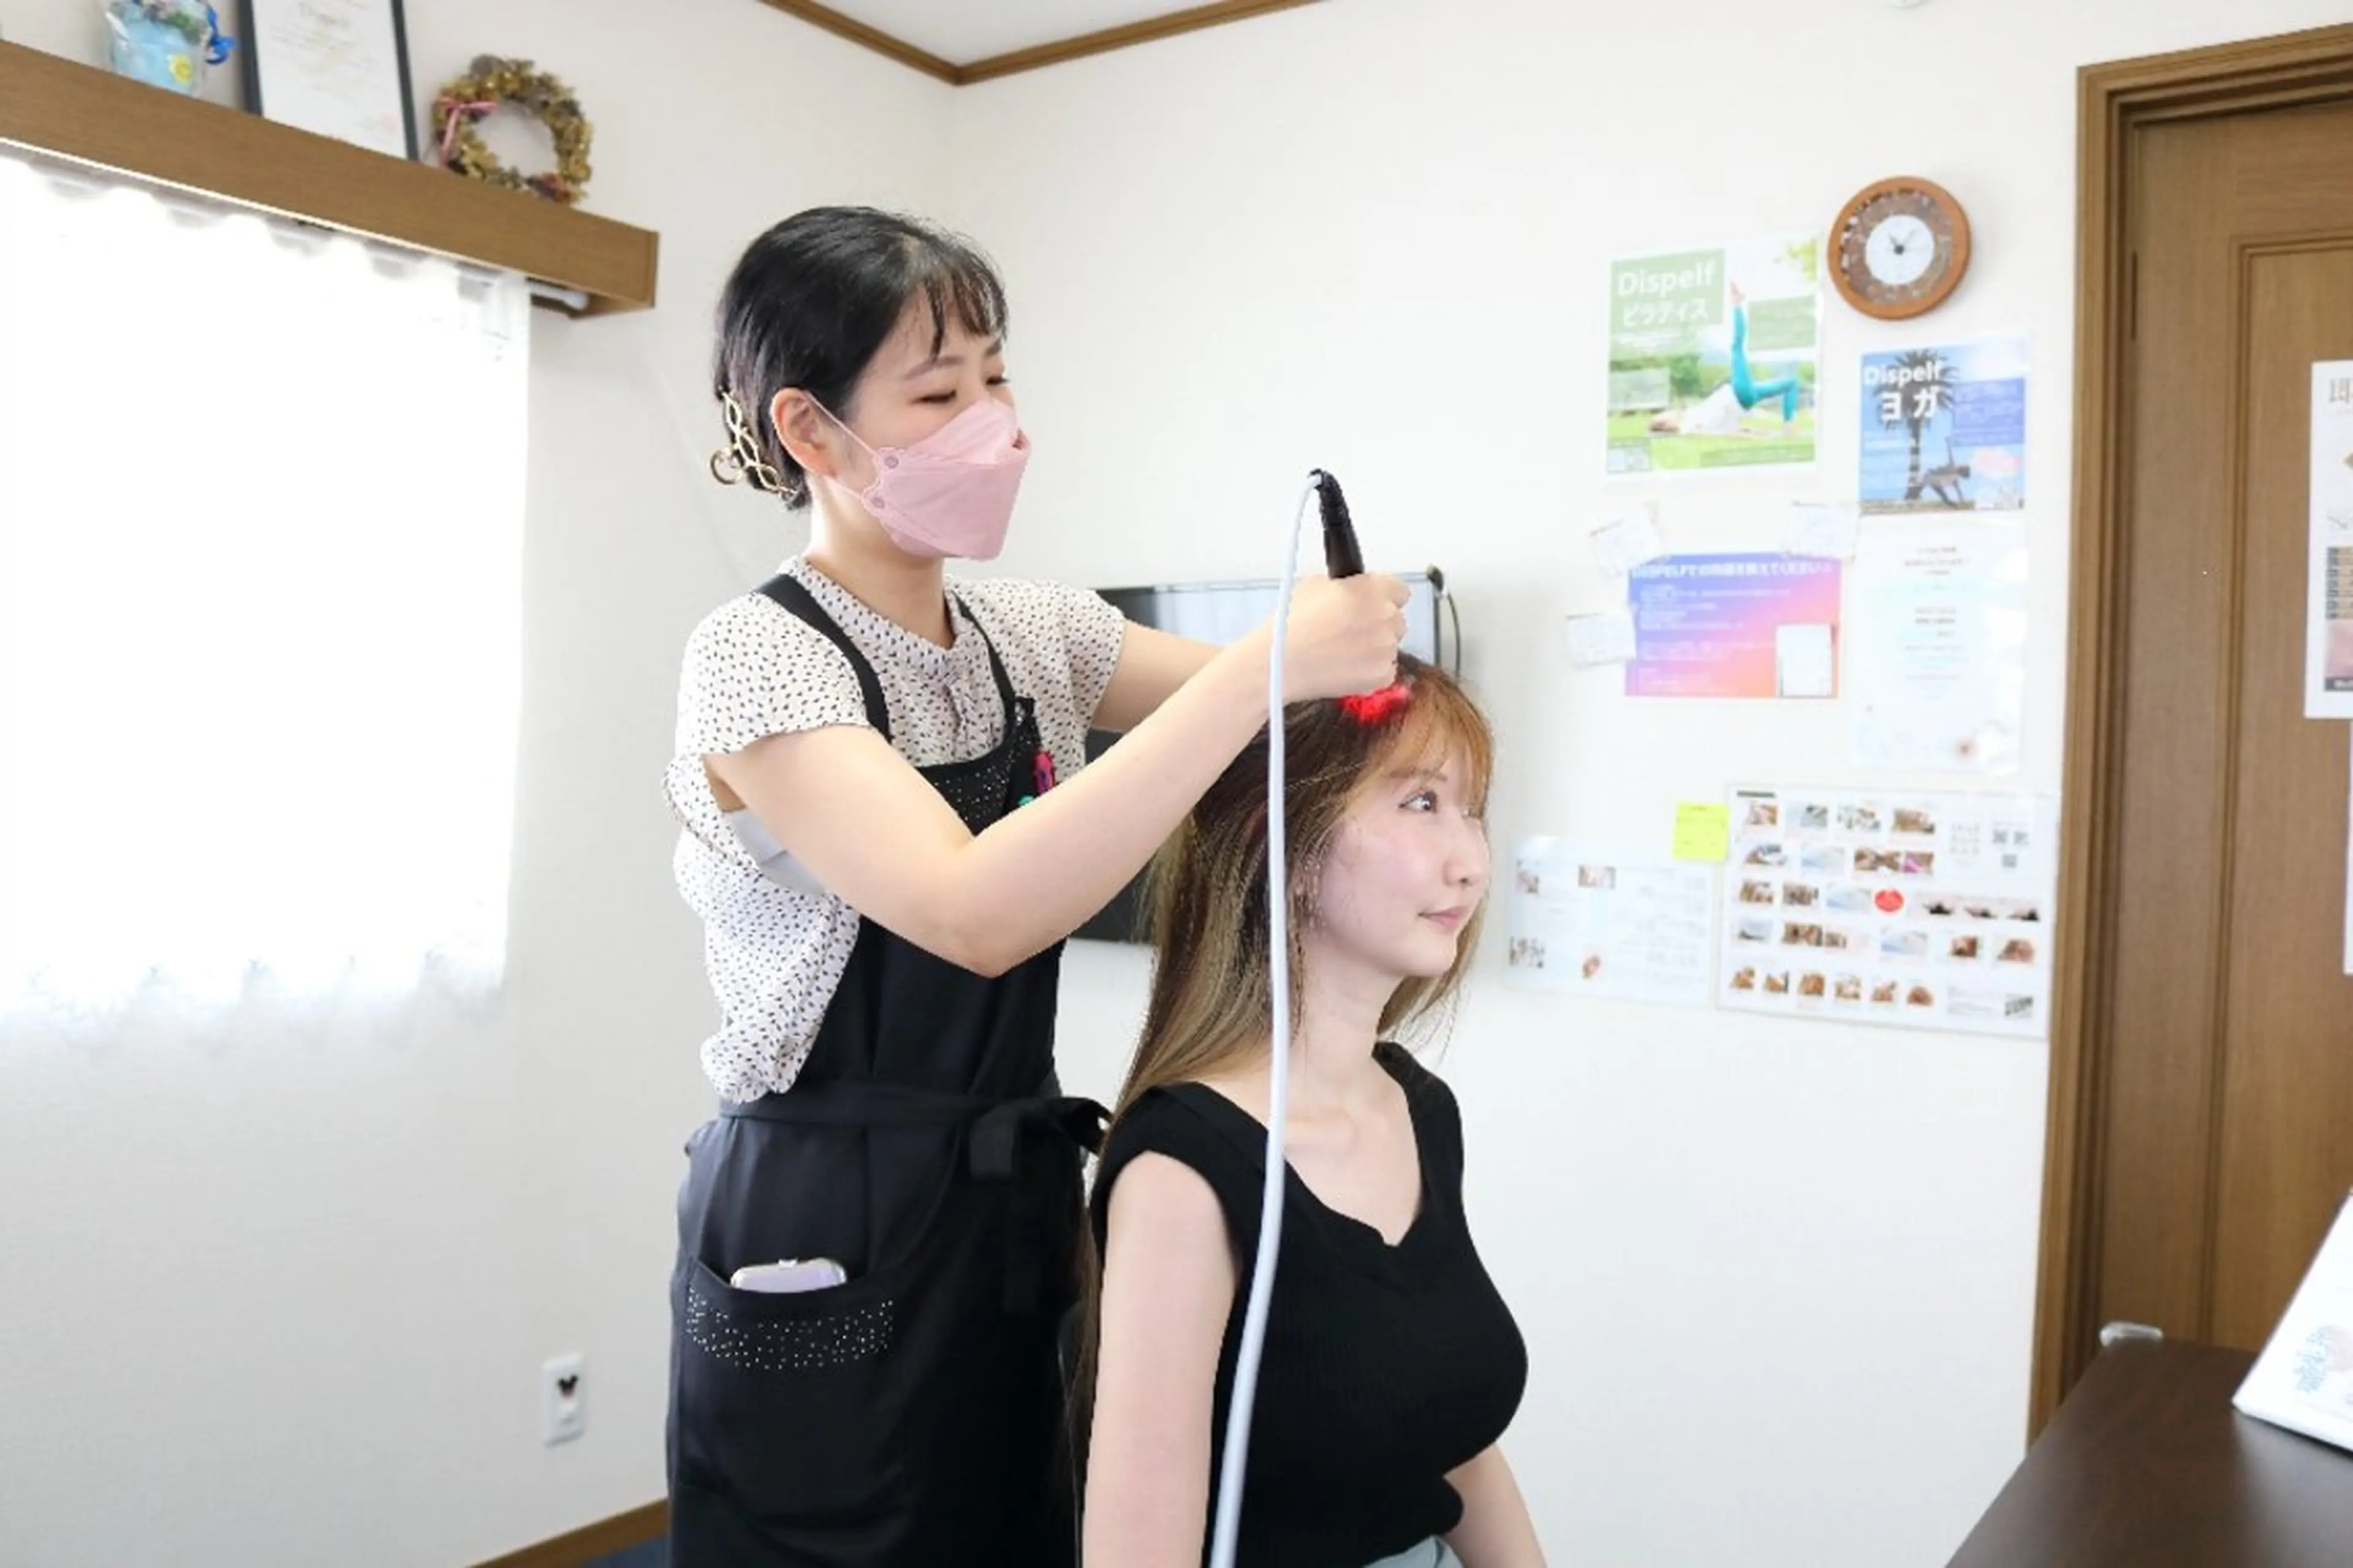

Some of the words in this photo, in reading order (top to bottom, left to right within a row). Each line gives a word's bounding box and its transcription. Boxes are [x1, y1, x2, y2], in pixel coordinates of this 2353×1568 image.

[1617, 260, 1716, 298] Dispelf
[1623, 298, 1710, 327] ピラティス
[1864, 360, 1942, 388] Dispelf
[1881, 385, 1940, 420] ヨガ
